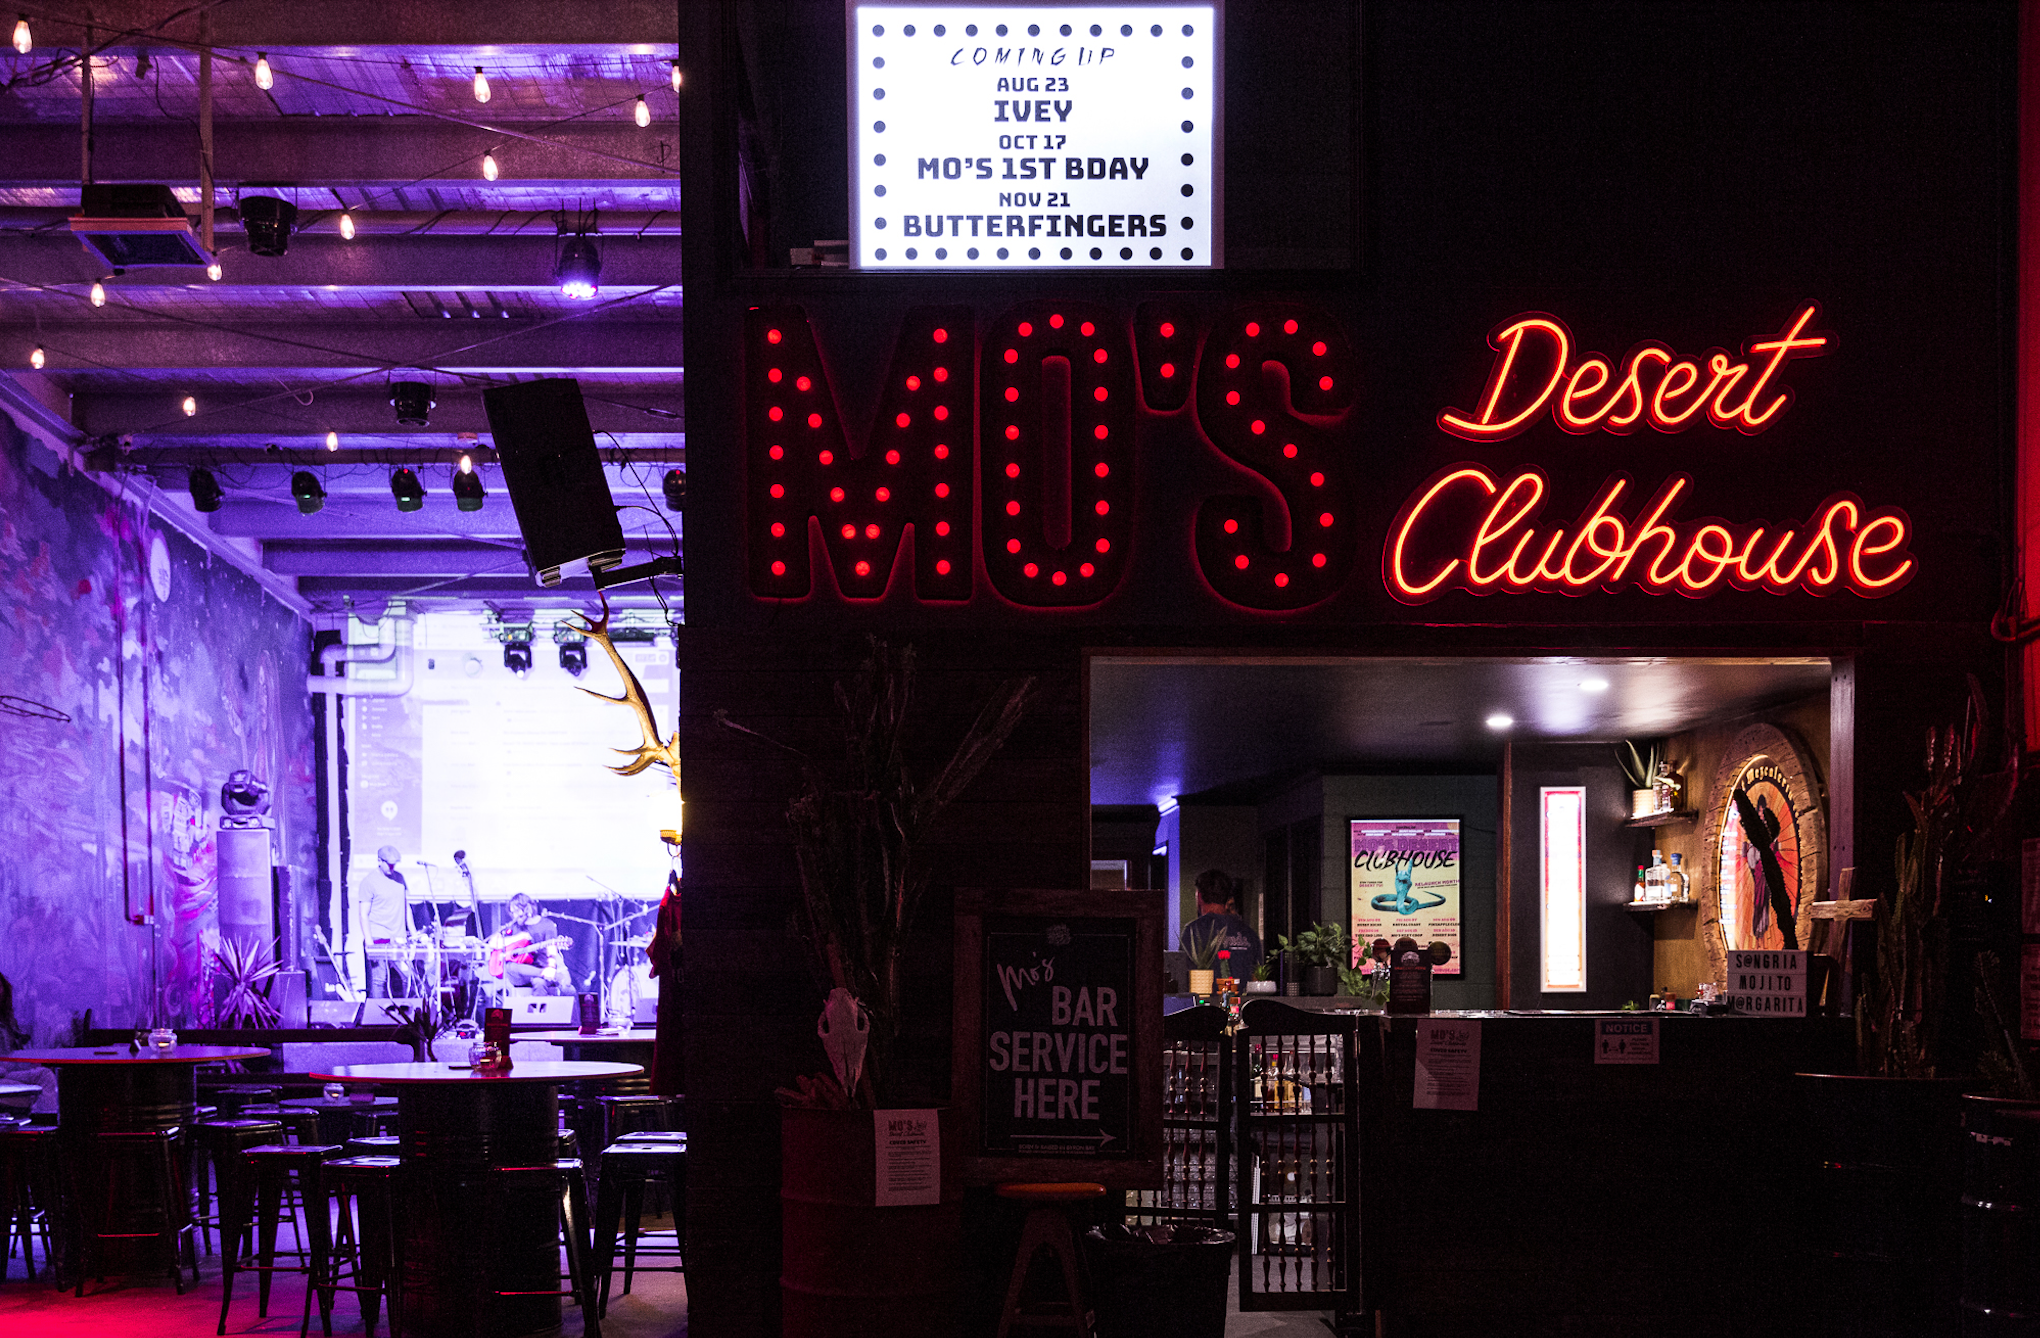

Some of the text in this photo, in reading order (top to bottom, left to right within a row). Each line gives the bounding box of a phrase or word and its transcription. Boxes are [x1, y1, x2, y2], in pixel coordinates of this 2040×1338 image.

[950, 47, 1115, 66] COMING UP
[997, 77, 1070, 92] AUG 23
[994, 100, 1073, 122] IVEY
[999, 135, 1067, 150] OCT 17
[918, 157, 1150, 180] MO'S 1ST BDAY
[999, 192, 1070, 208] NOV 21
[904, 215, 1167, 238] BUTTERFINGERS
[1441, 304, 1828, 433] Desert
[745, 304, 1356, 612] MO'S
[1393, 467, 1914, 595] Clubhouse
[1398, 838, 1459, 851] DESERT
[997, 951, 1055, 1011] Mo's
[1739, 975, 1792, 991] MOJITO
[1052, 985, 1118, 1026] BAR
[1605, 1024, 1648, 1033] NOTICE
[989, 1031, 1128, 1074] SERVICE
[1014, 1078, 1100, 1120] HERE
